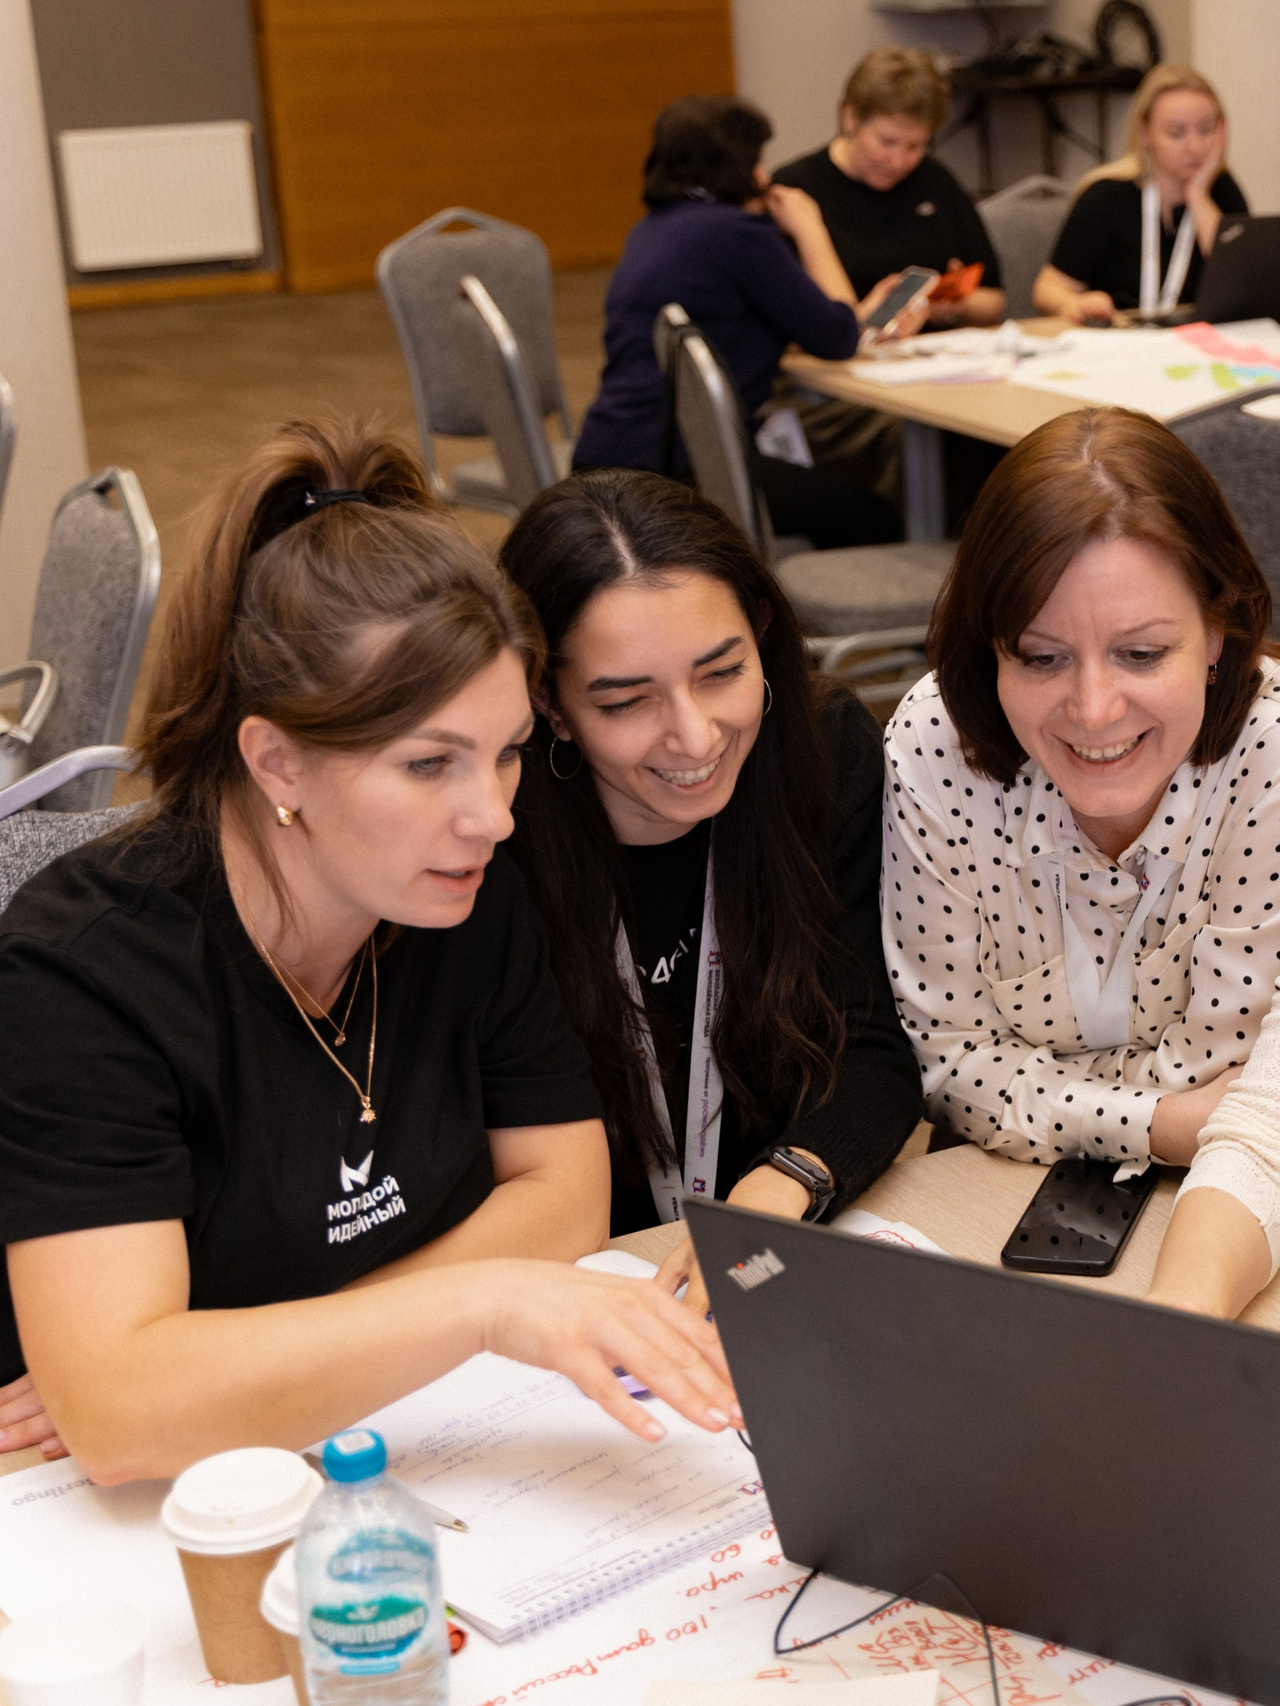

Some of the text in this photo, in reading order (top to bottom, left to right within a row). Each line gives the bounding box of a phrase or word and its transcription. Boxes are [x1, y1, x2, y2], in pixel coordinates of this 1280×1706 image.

[327, 1175, 400, 1221] МОЛДОЙ
[327, 1195, 407, 1244] ИДЕЙНЫЙ
[12, 1477, 96, 1506] erlingo
